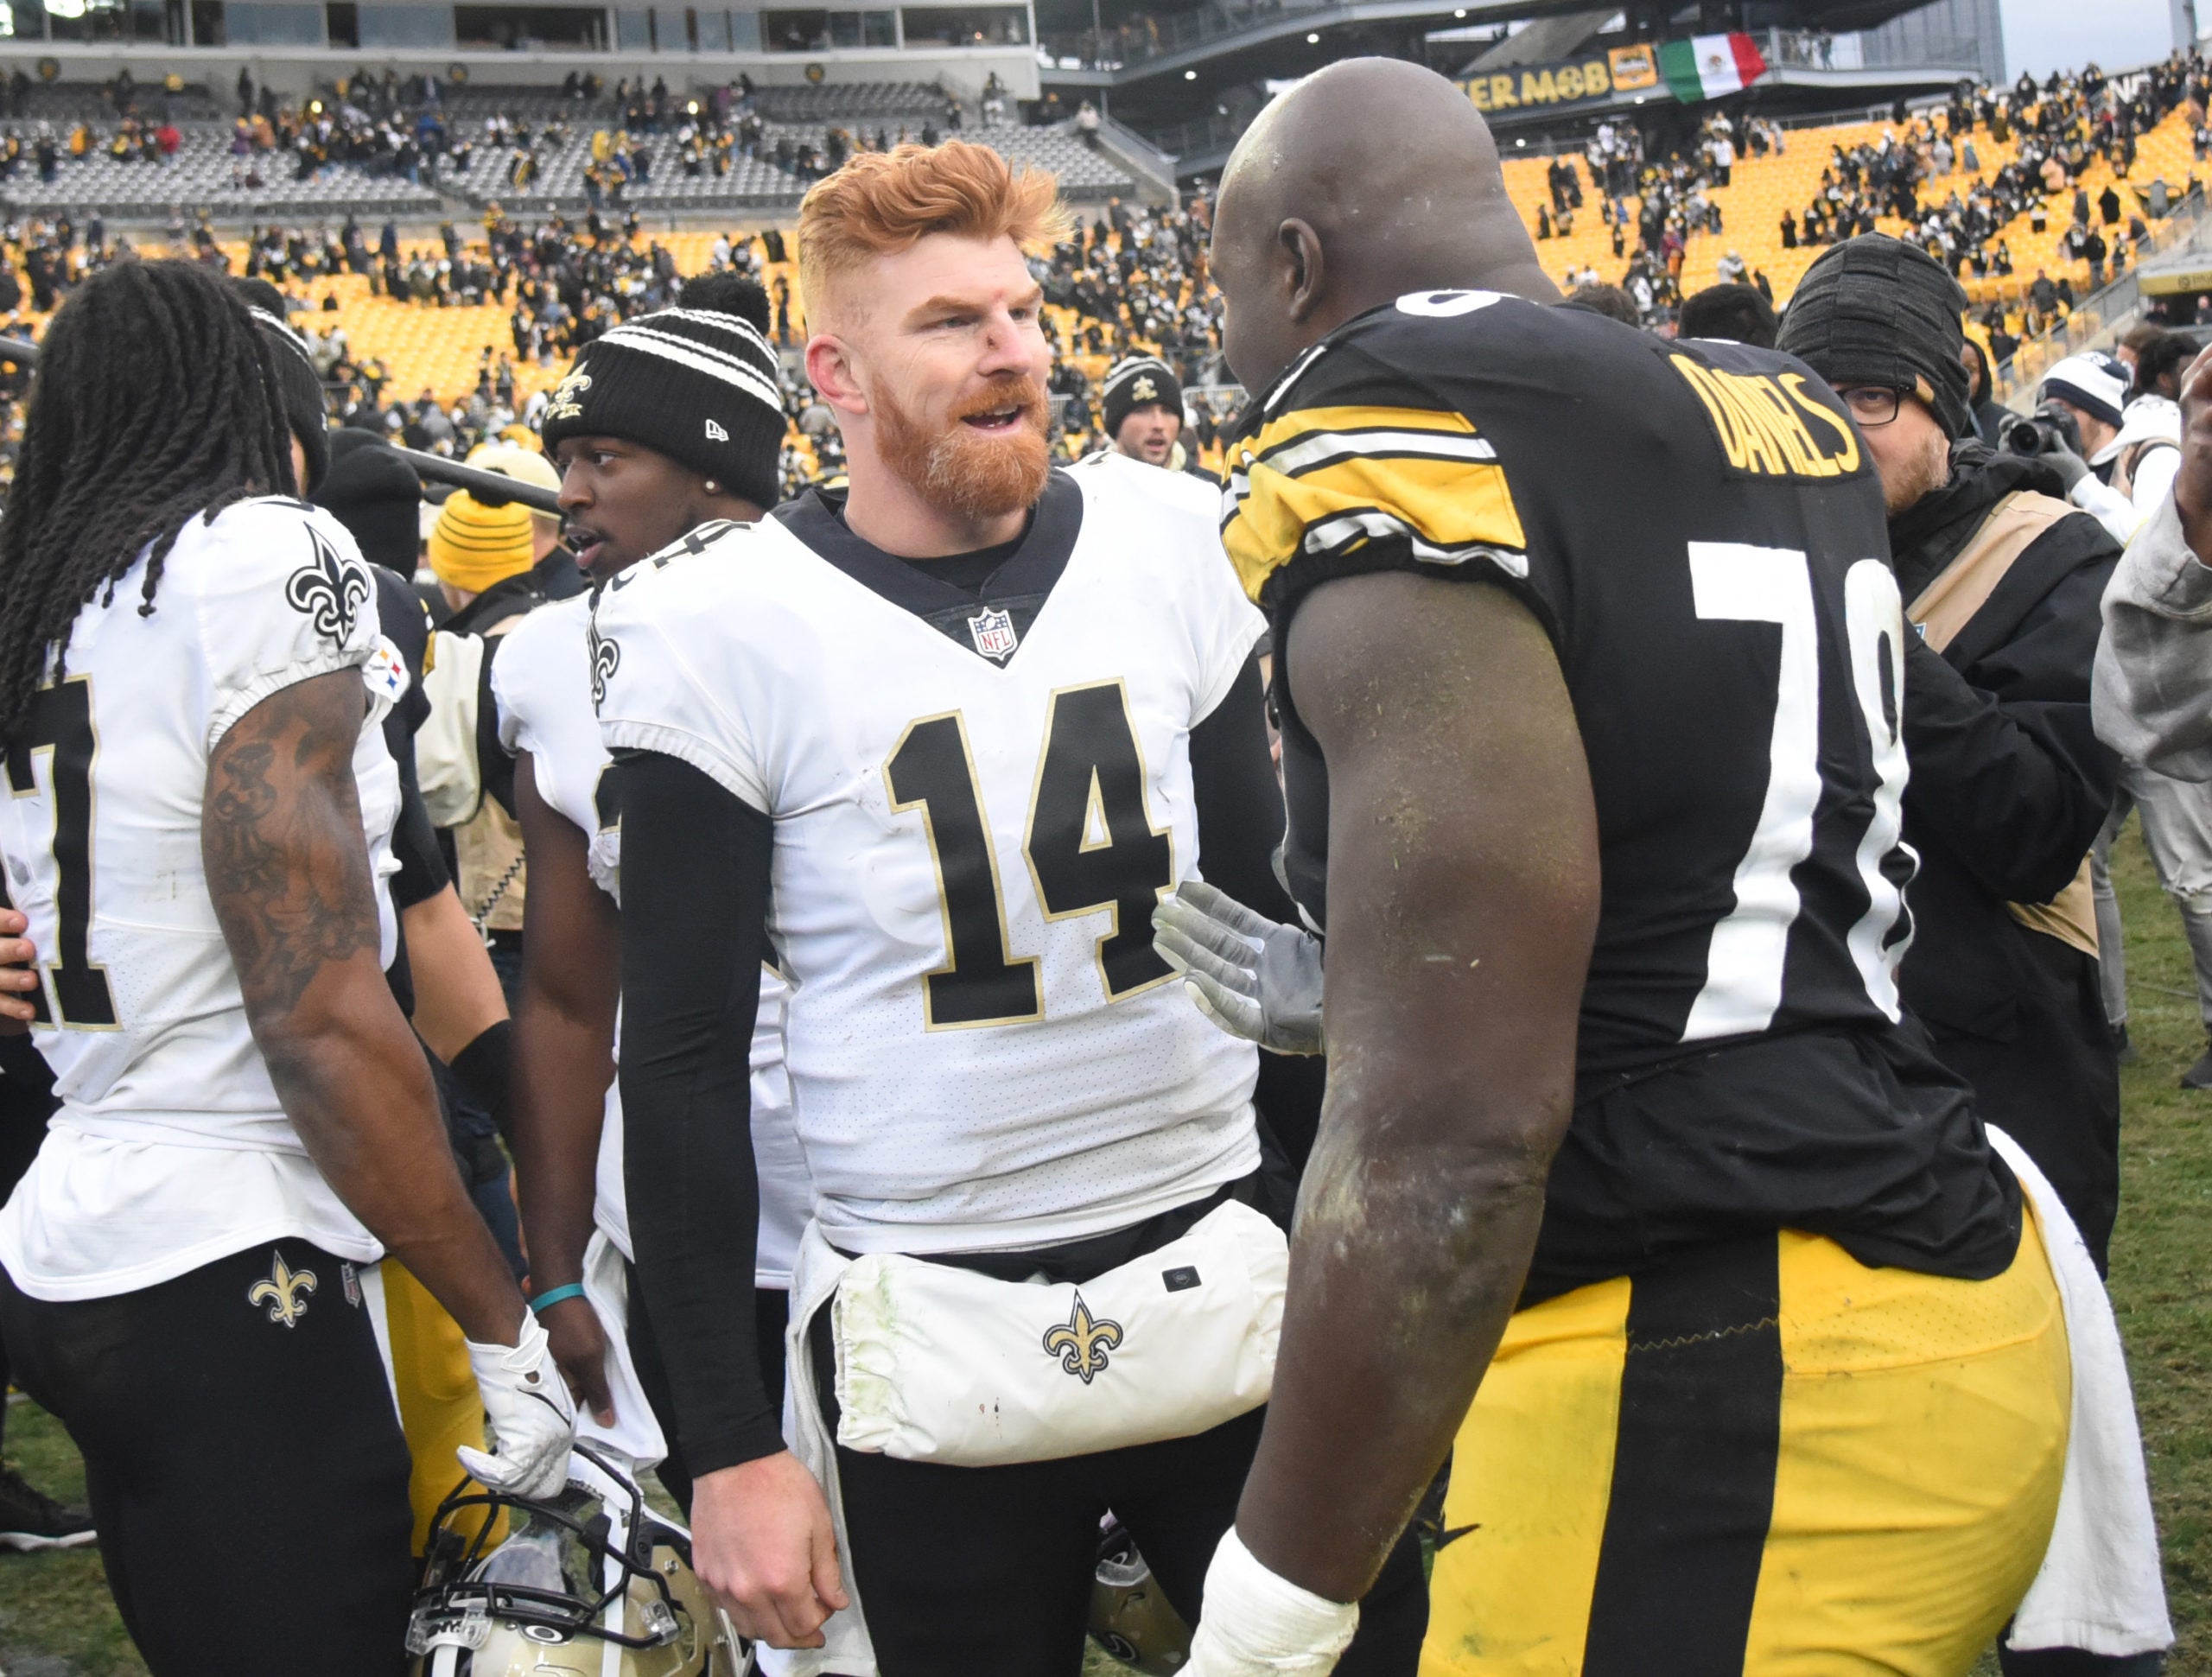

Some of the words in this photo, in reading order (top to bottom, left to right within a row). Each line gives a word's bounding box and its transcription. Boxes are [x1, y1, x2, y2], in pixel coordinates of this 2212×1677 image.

[1521, 60, 1610, 105] MOB
[1669, 353, 1860, 478] DANIELS
[981, 630, 1011, 651] NFL
[881, 676, 1185, 1032] 14
